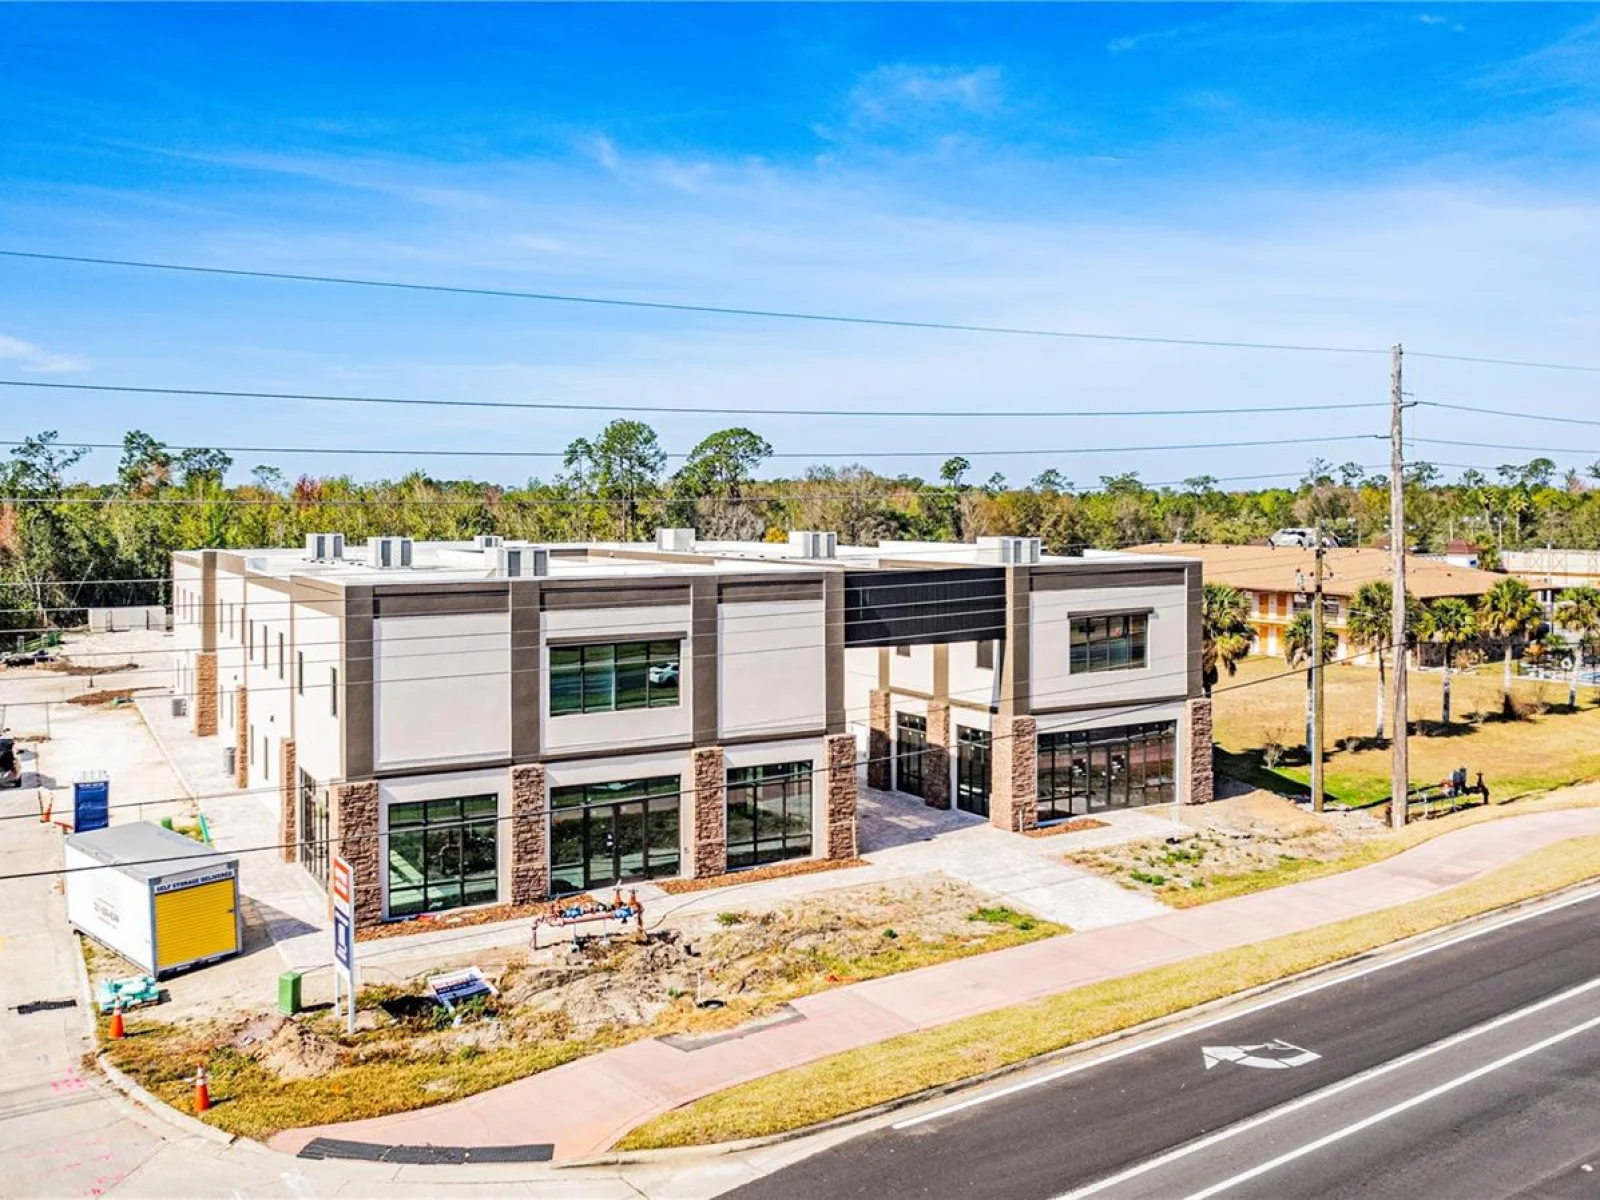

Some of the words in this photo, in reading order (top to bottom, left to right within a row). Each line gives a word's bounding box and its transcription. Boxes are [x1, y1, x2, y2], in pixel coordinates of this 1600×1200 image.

[157, 884, 171, 892] SELF
[173, 878, 199, 888] STORAGE
[201, 871, 233, 882] DELIVERED
